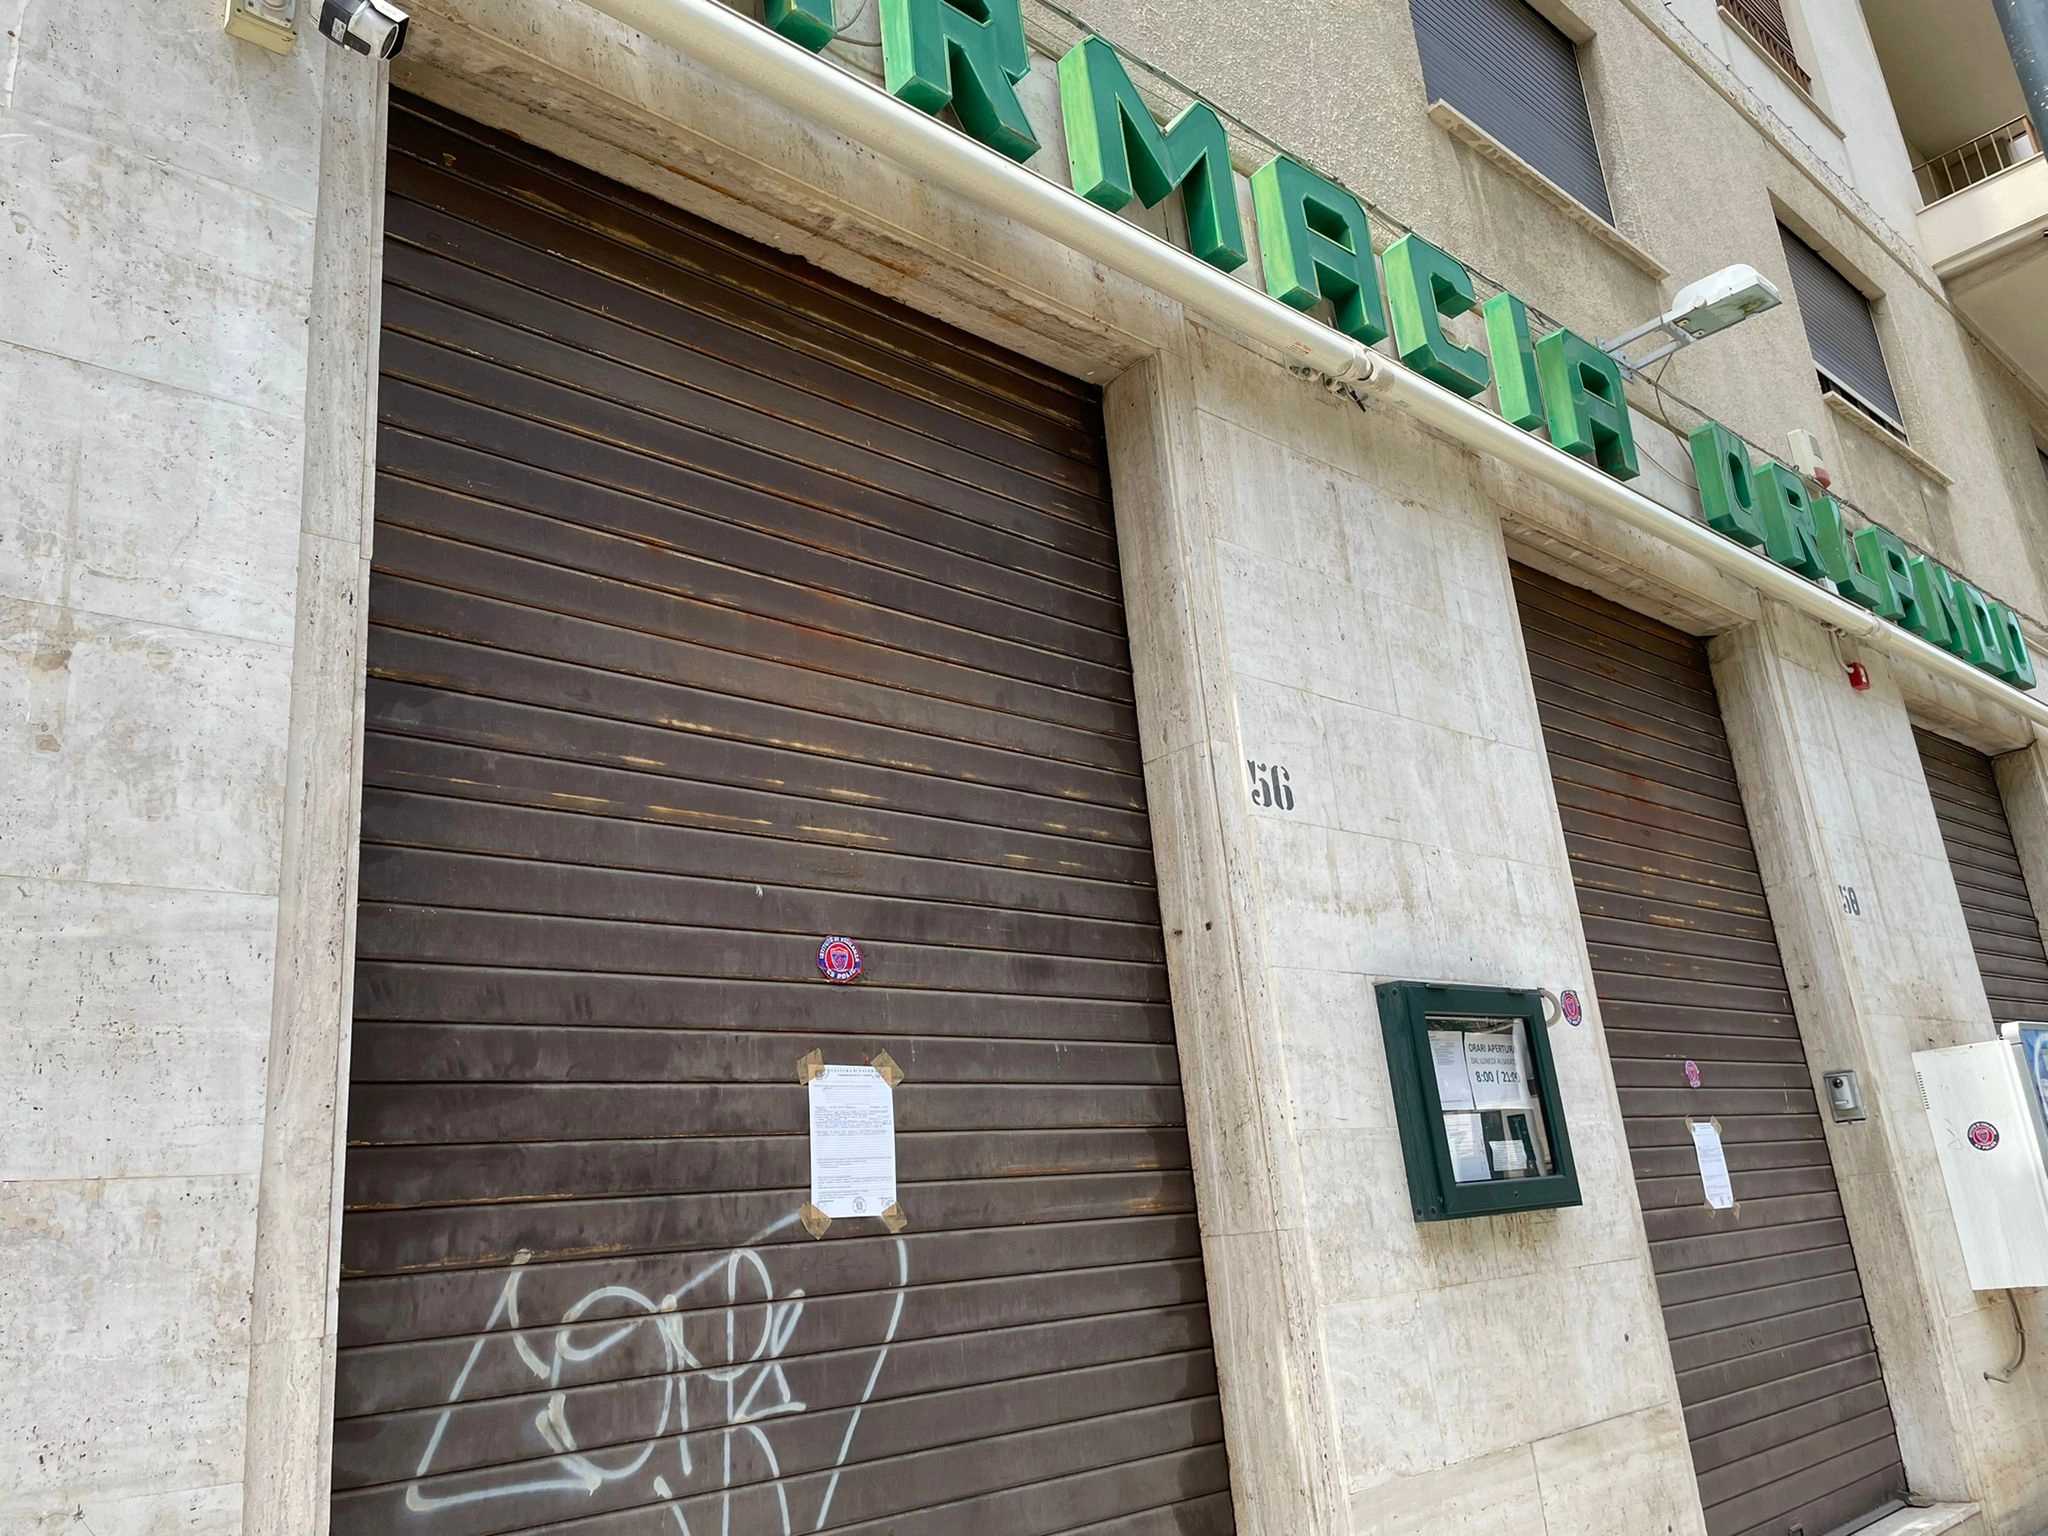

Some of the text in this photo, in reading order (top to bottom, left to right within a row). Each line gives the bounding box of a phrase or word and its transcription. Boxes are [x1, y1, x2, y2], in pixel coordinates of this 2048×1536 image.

[764, 0, 2036, 690] RMACIA ORLANDO
[1247, 759, 1294, 811] 56
[1838, 884, 1860, 916] 58
[1468, 1043, 1514, 1054] ORARI APERTUR
[1475, 1071, 1494, 1083] 8:00
